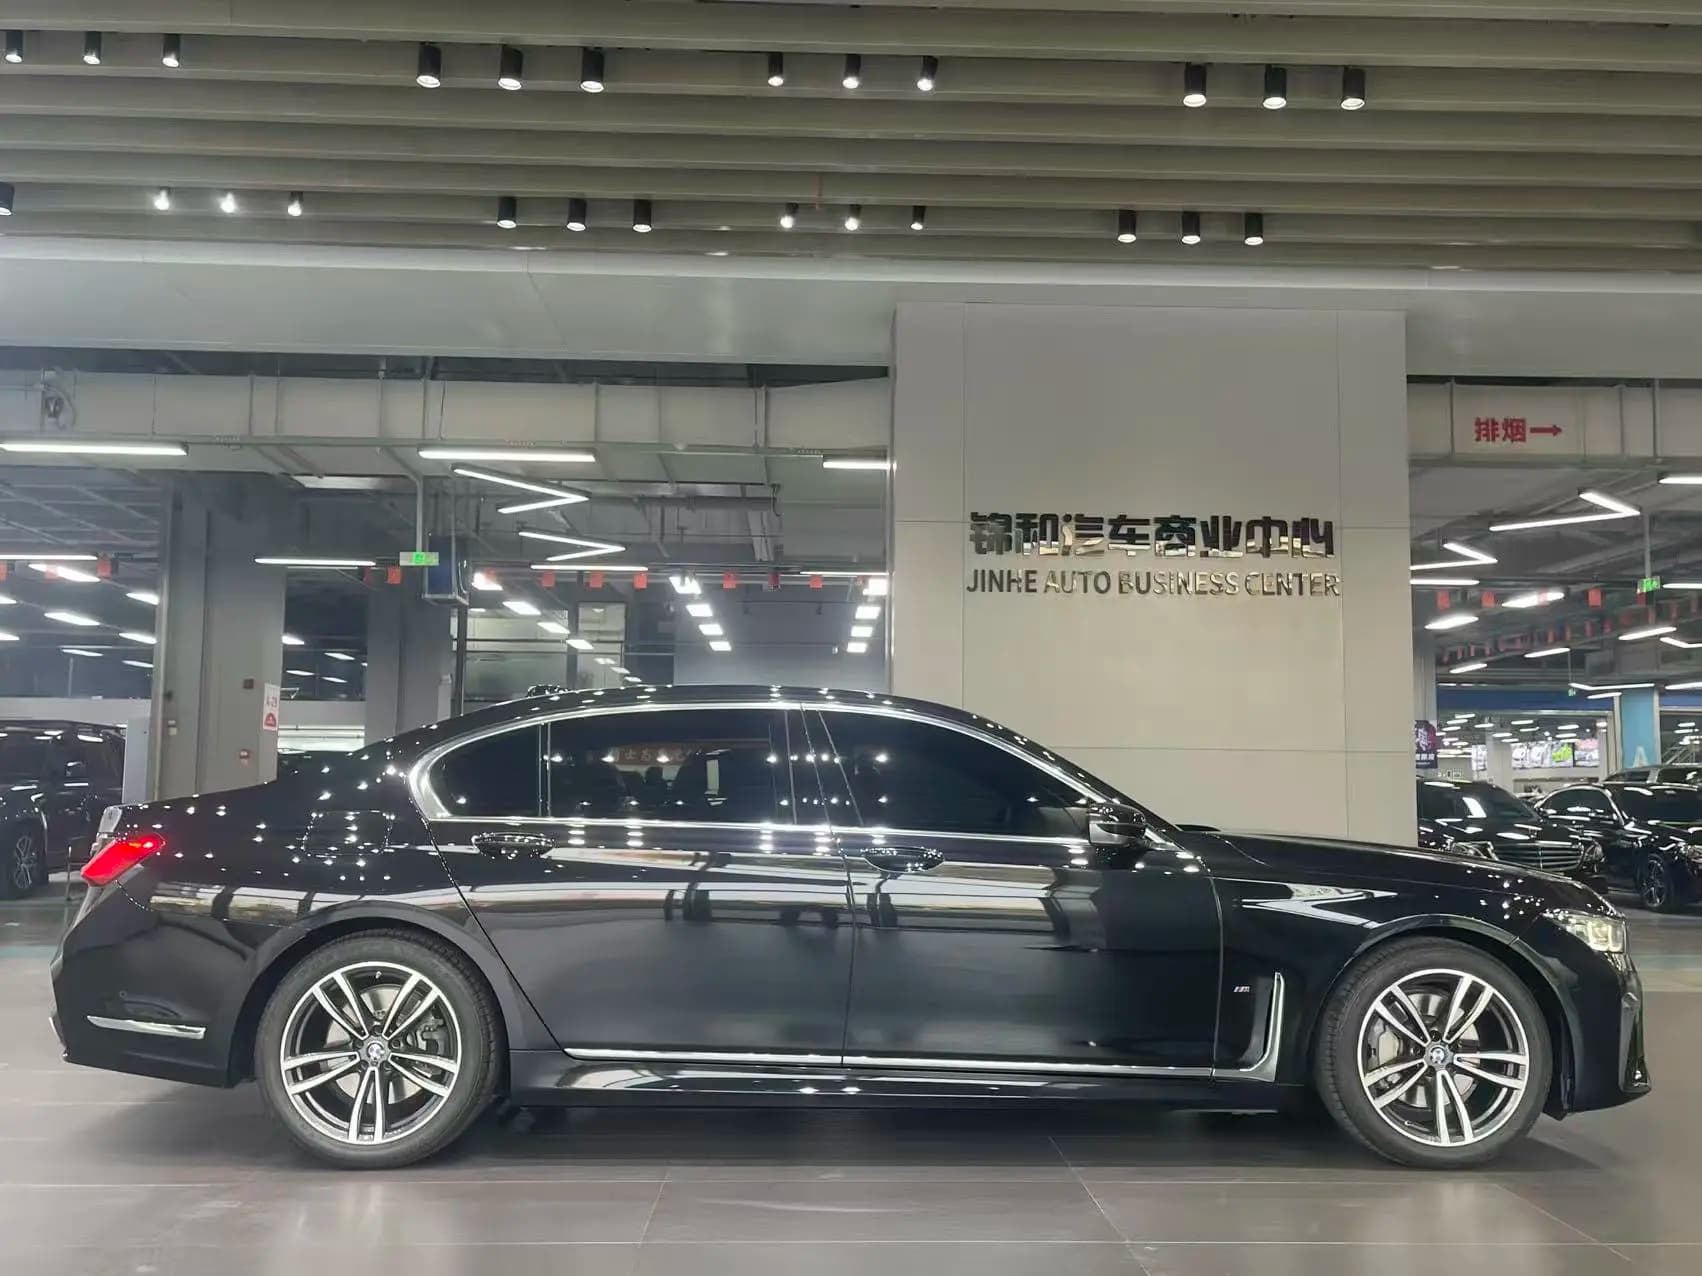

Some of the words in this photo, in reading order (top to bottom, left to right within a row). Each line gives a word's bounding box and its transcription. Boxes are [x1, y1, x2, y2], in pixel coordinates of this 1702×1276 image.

[1474, 417, 1527, 442] 排烟
[969, 512, 1334, 558] 锦和汽车商业中心
[967, 569, 1038, 593] JINHE
[1043, 570, 1112, 594] AUTO
[1118, 571, 1239, 596] BUSINESS
[1244, 571, 1341, 597] CENTER
